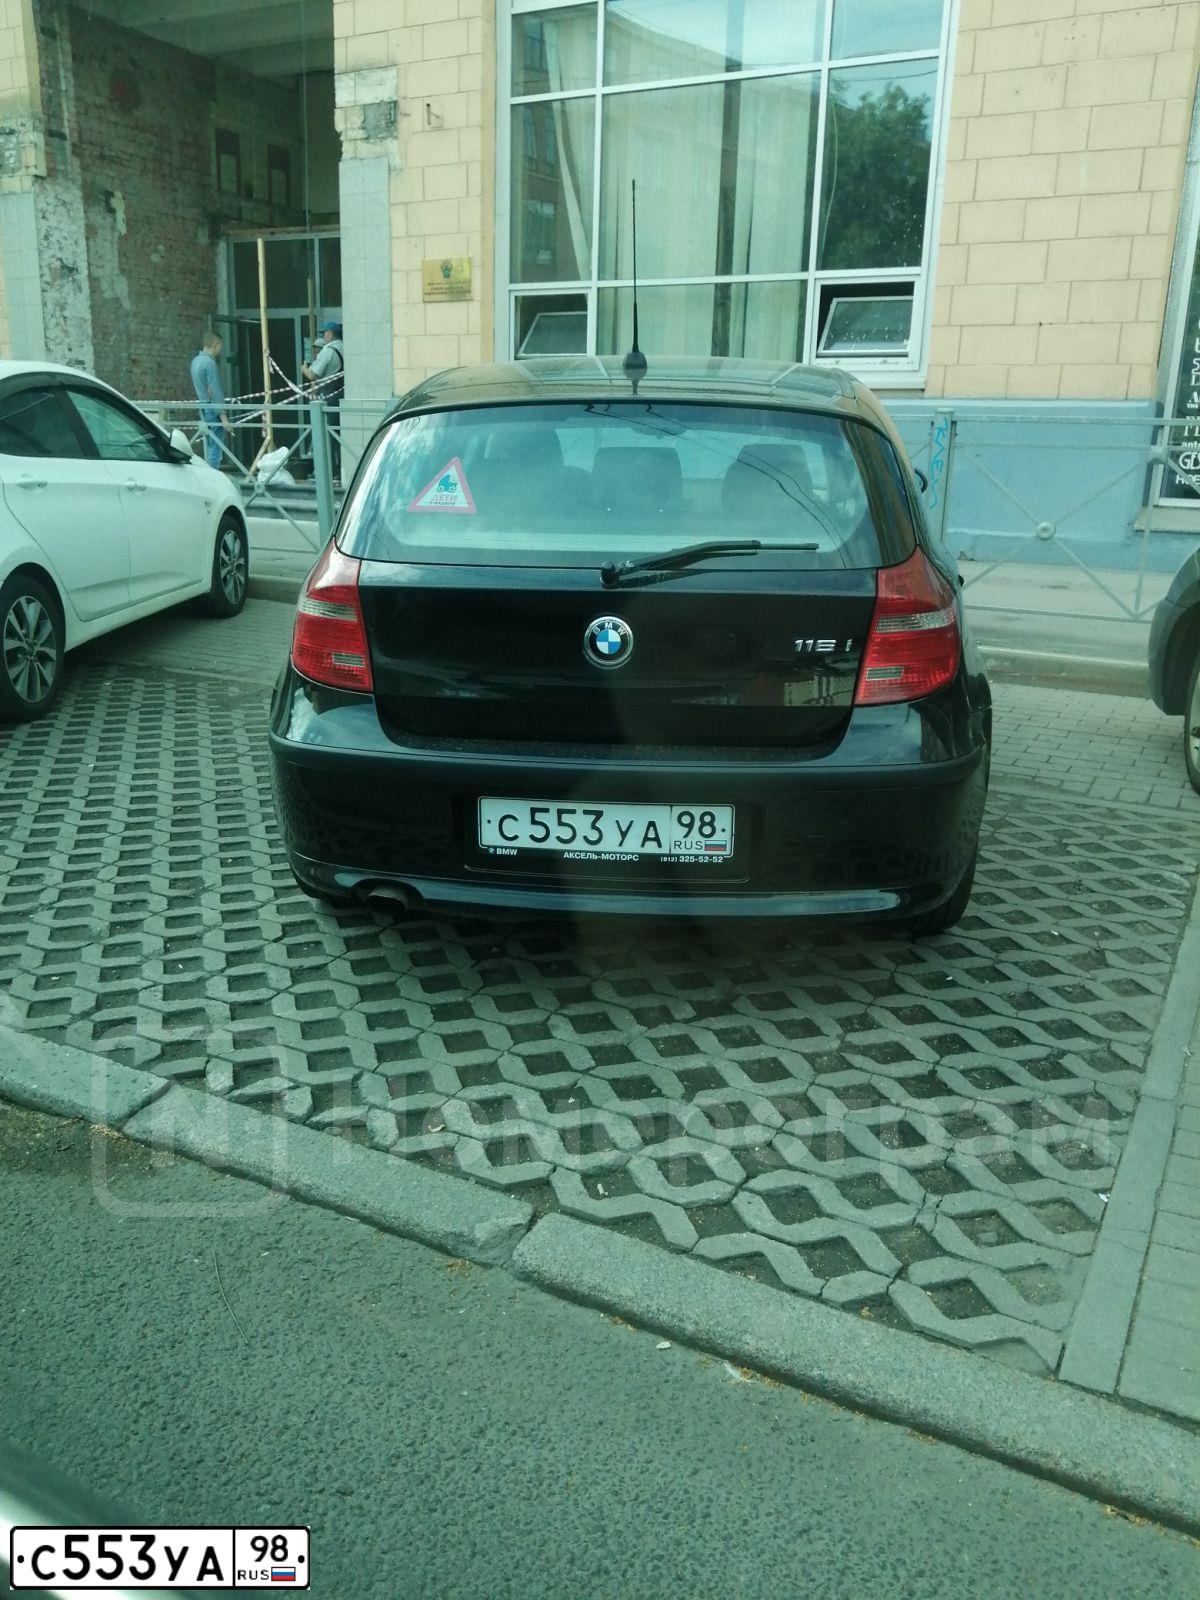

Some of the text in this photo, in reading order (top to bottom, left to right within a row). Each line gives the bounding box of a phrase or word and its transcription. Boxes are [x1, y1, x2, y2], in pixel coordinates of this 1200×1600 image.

[592, 622, 627, 636] BMW
[676, 810, 717, 839] 98
[673, 840, 703, 850] RUS
[496, 847, 518, 856] BMW
[563, 851, 640, 862] АКСЕЛЬ-МОТОРС
[679, 855, 724, 863] 325-52-52
